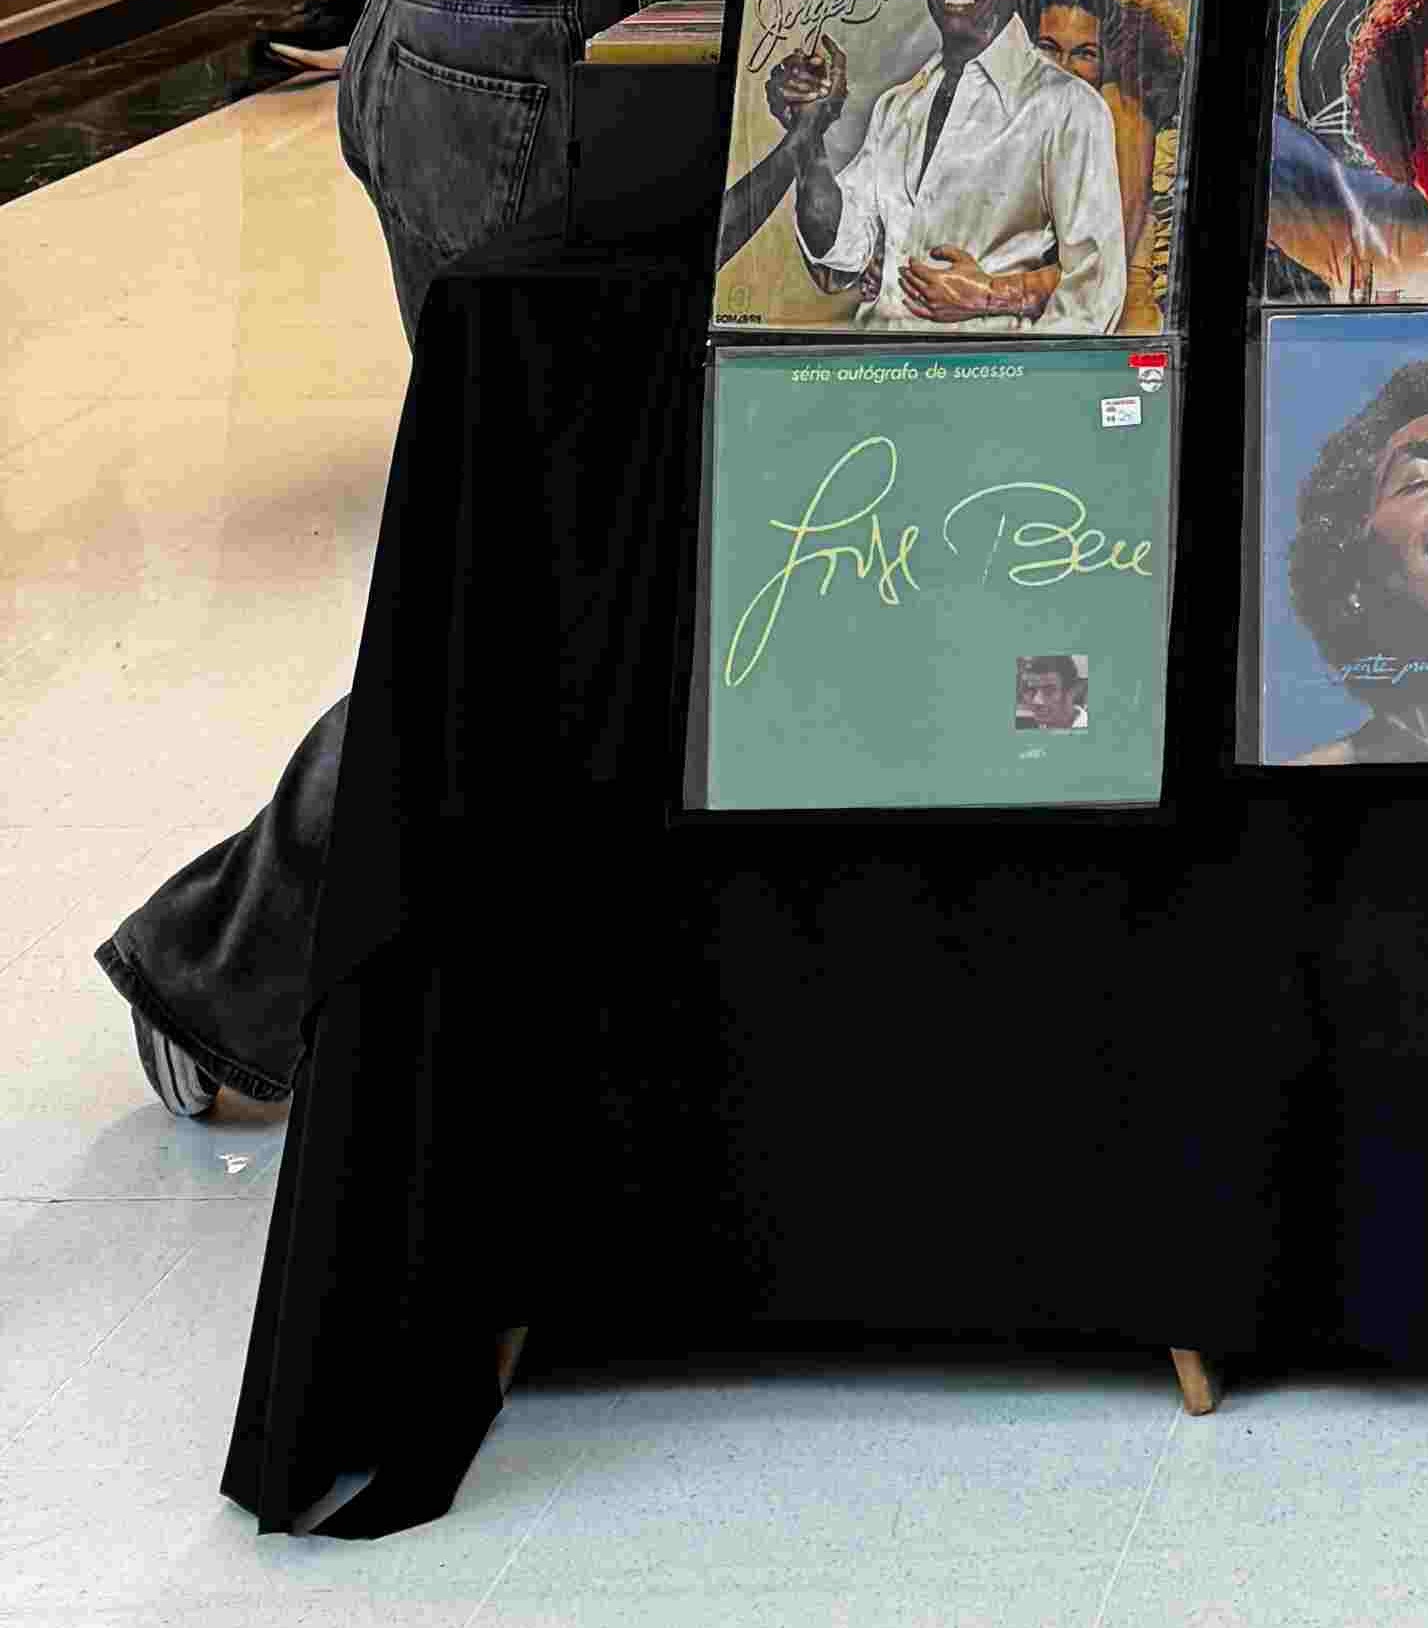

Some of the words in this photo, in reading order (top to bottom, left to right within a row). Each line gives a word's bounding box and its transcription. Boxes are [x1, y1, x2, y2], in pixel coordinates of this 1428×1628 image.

[791, 364, 831, 382] série
[837, 361, 919, 384] autógrafo
[925, 359, 948, 379] de
[952, 363, 1025, 380] sucessos
